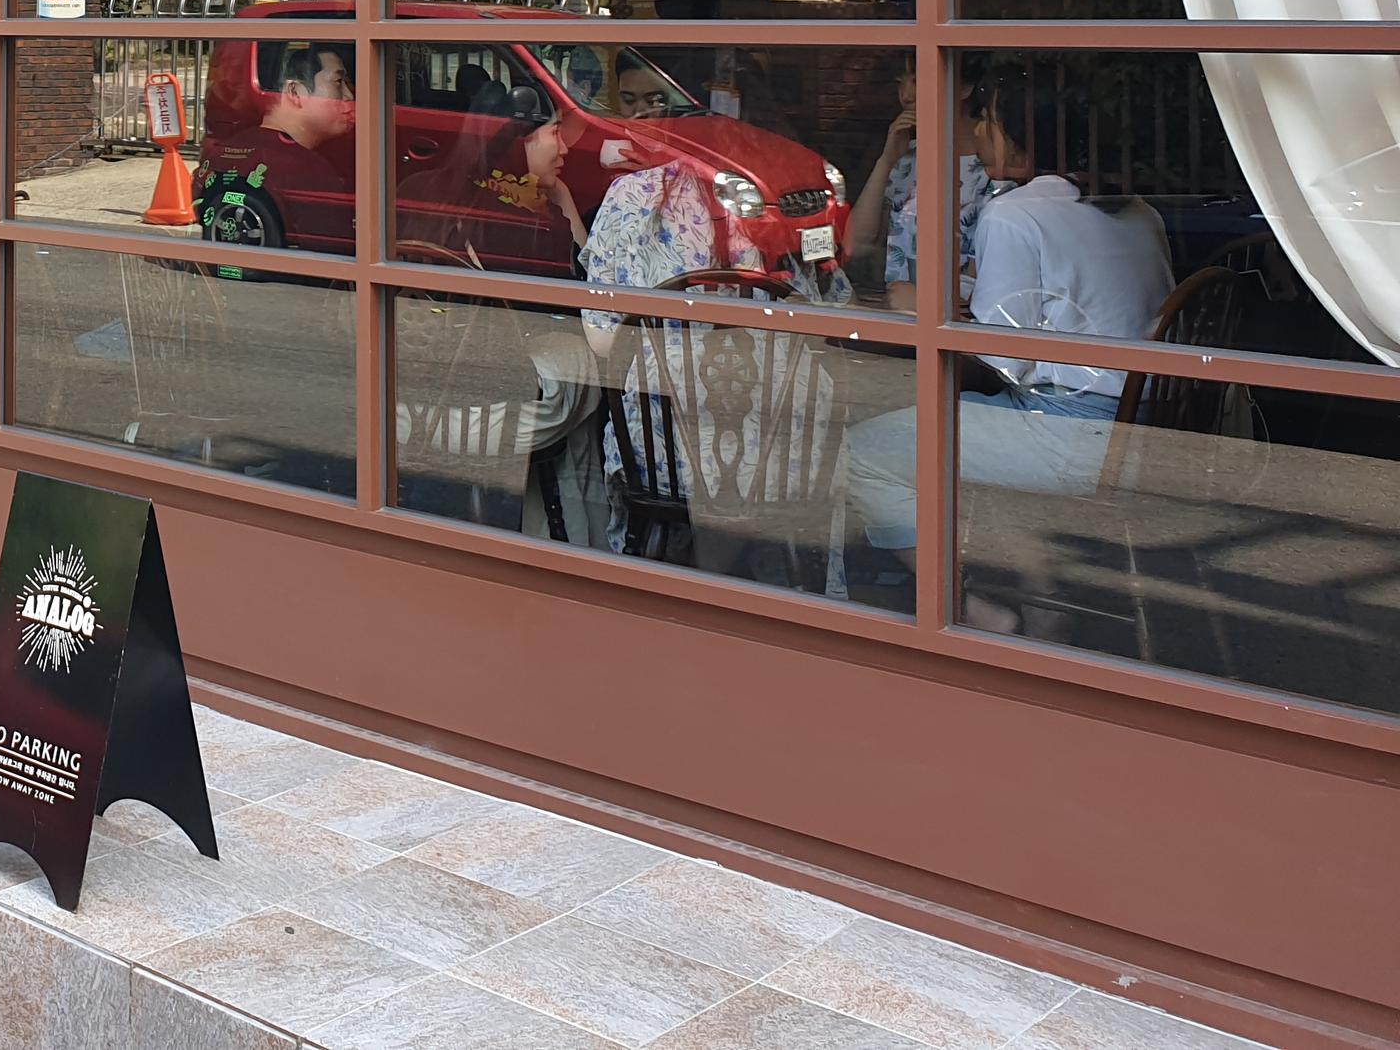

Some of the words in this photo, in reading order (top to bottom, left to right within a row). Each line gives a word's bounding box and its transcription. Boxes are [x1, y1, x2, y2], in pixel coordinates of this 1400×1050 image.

[21, 594, 95, 637] ANALOG
[11, 731, 81, 772] PARKING
[11, 781, 33, 795] AWAY
[34, 789, 55, 804] ZONE
